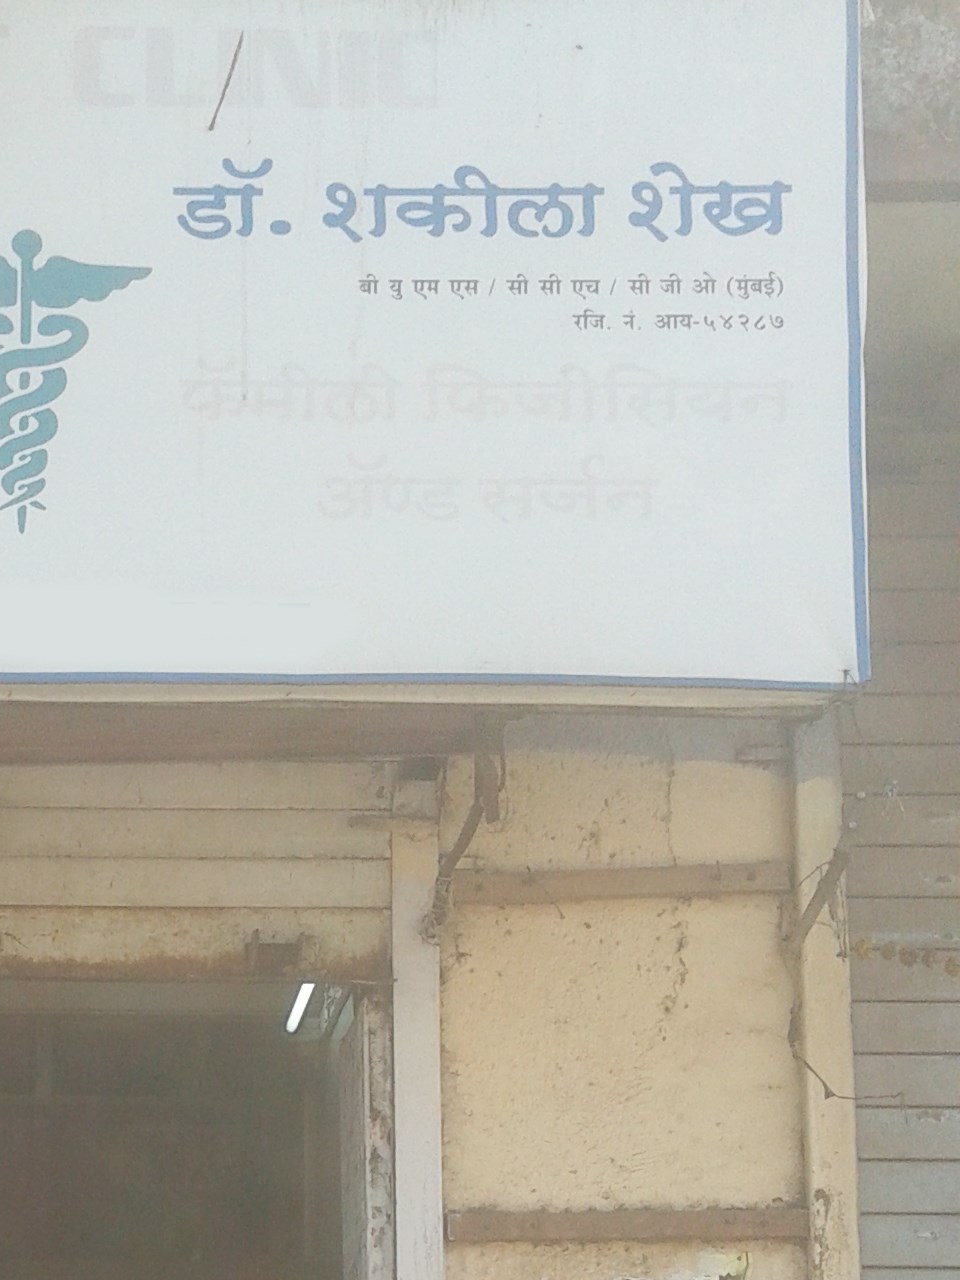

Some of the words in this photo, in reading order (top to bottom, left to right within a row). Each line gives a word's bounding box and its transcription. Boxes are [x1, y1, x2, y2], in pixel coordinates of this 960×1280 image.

[72, 26, 440, 108] CLINIC
[174, 158, 292, 240] डॉ.
[323, 165, 605, 243] शकीला
[629, 162, 793, 243] शेख
[359, 274, 381, 296] बी
[412, 280, 442, 300] एम
[449, 280, 480, 301] एस
[506, 274, 530, 296] सी
[539, 274, 563, 296] सी
[571, 280, 602, 300] एच
[628, 273, 652, 296] सी
[661, 273, 683, 295] जी
[694, 272, 718, 295] ओ
